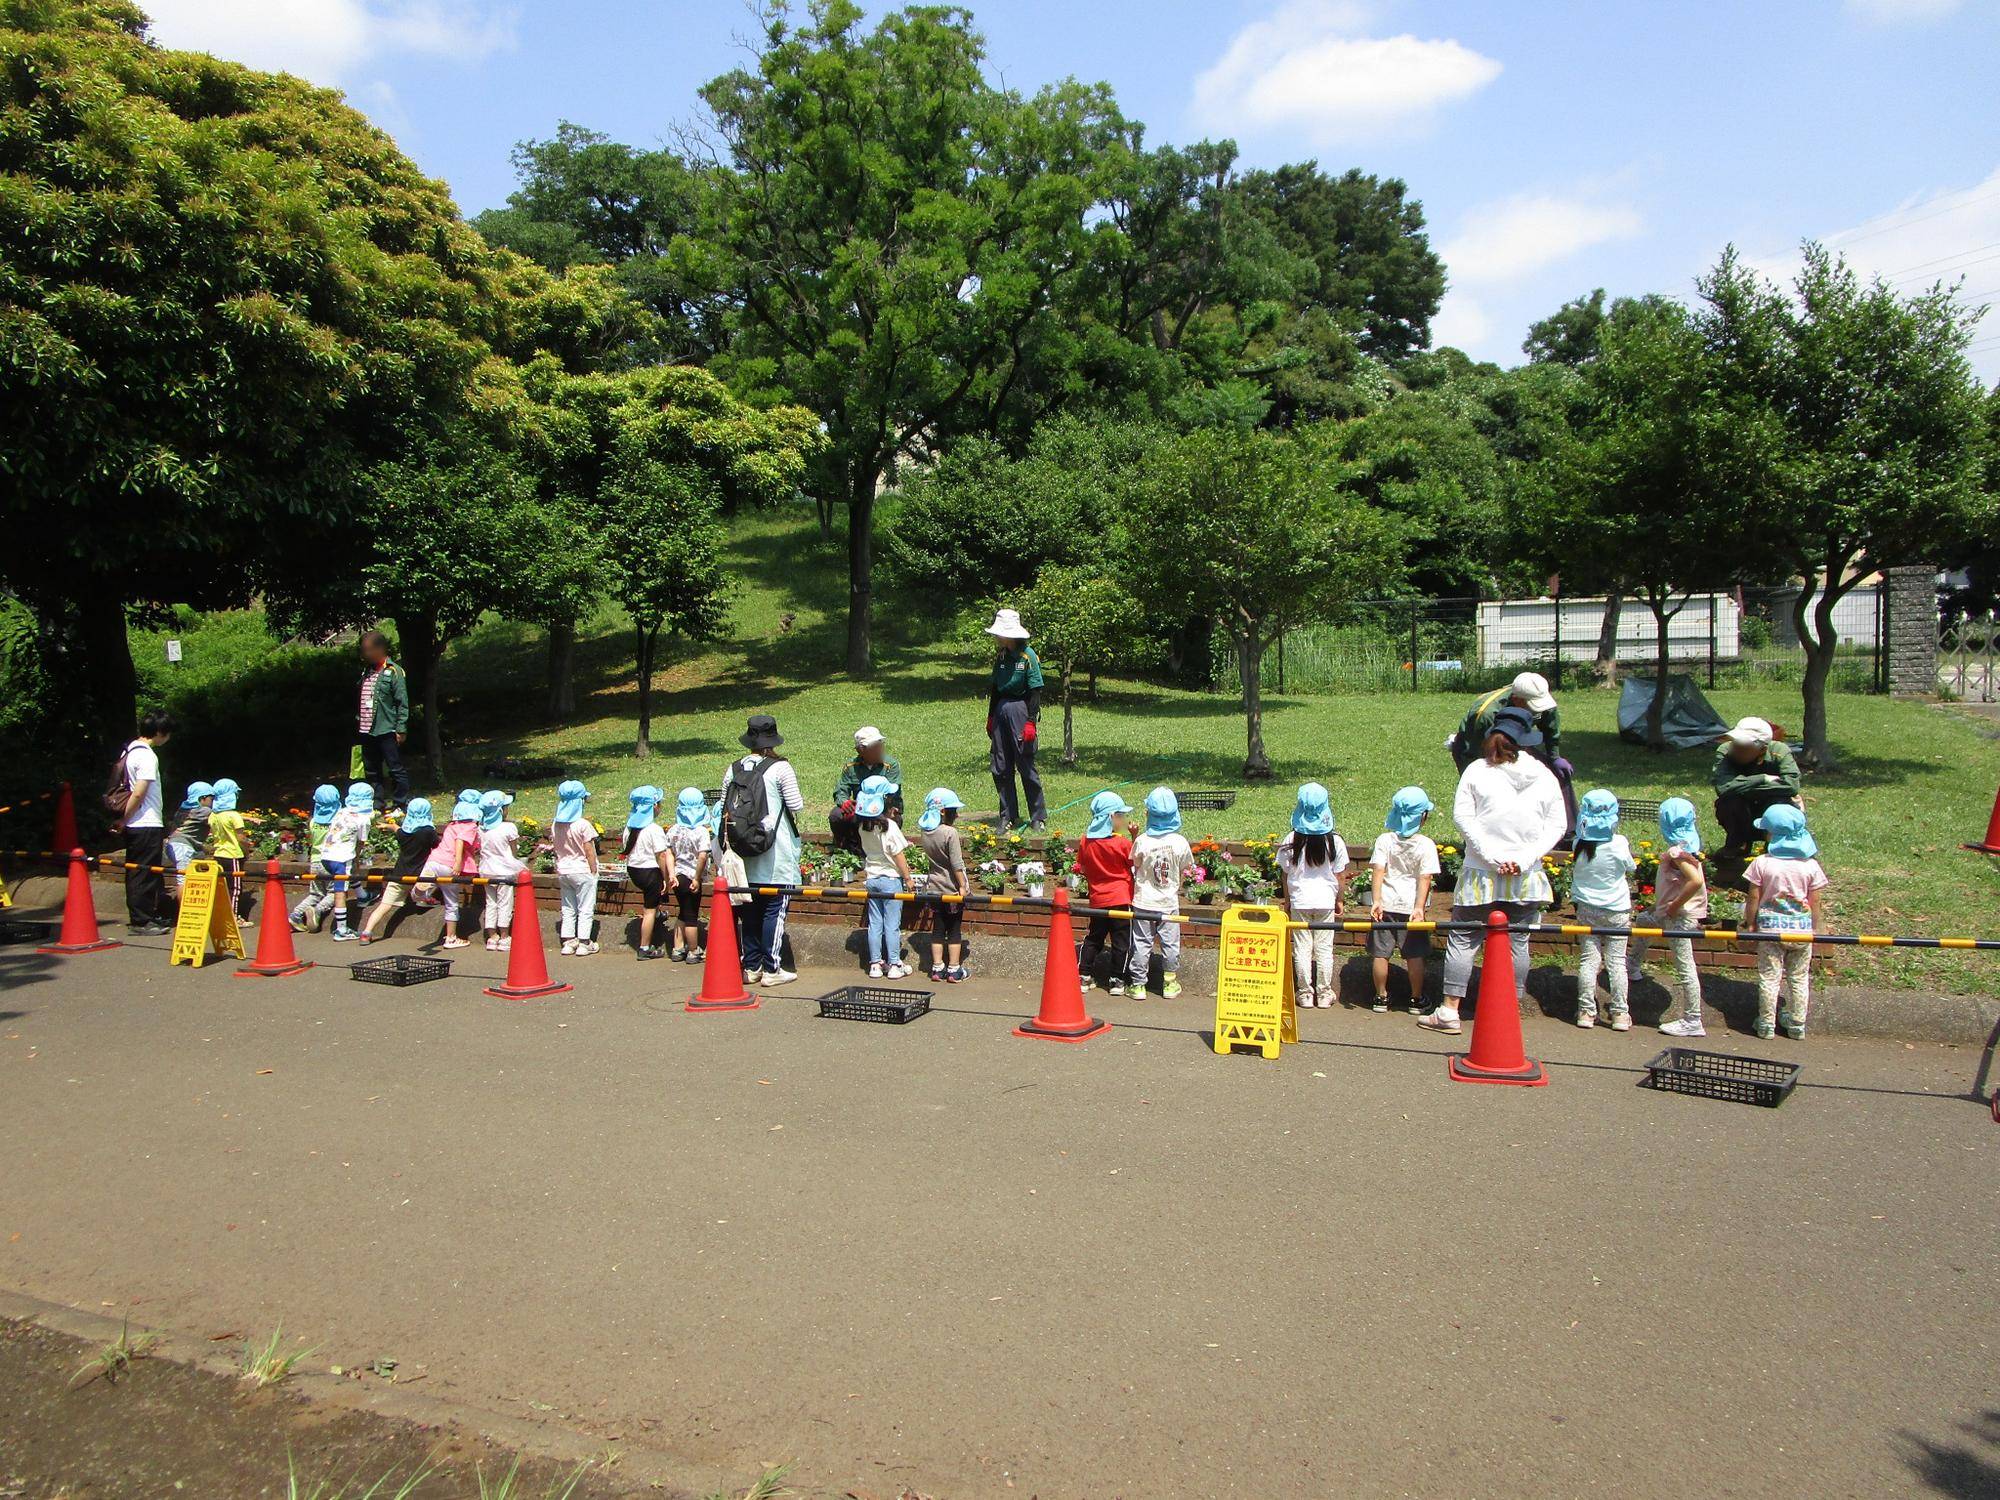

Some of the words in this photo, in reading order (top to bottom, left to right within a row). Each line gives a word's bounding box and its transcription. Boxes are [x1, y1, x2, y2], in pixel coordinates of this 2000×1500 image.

[1229, 936, 1276, 946] 公園ボランティア
[1236, 946, 1268, 955] 活動中
[1227, 956, 1275, 967] ご注意下さい
